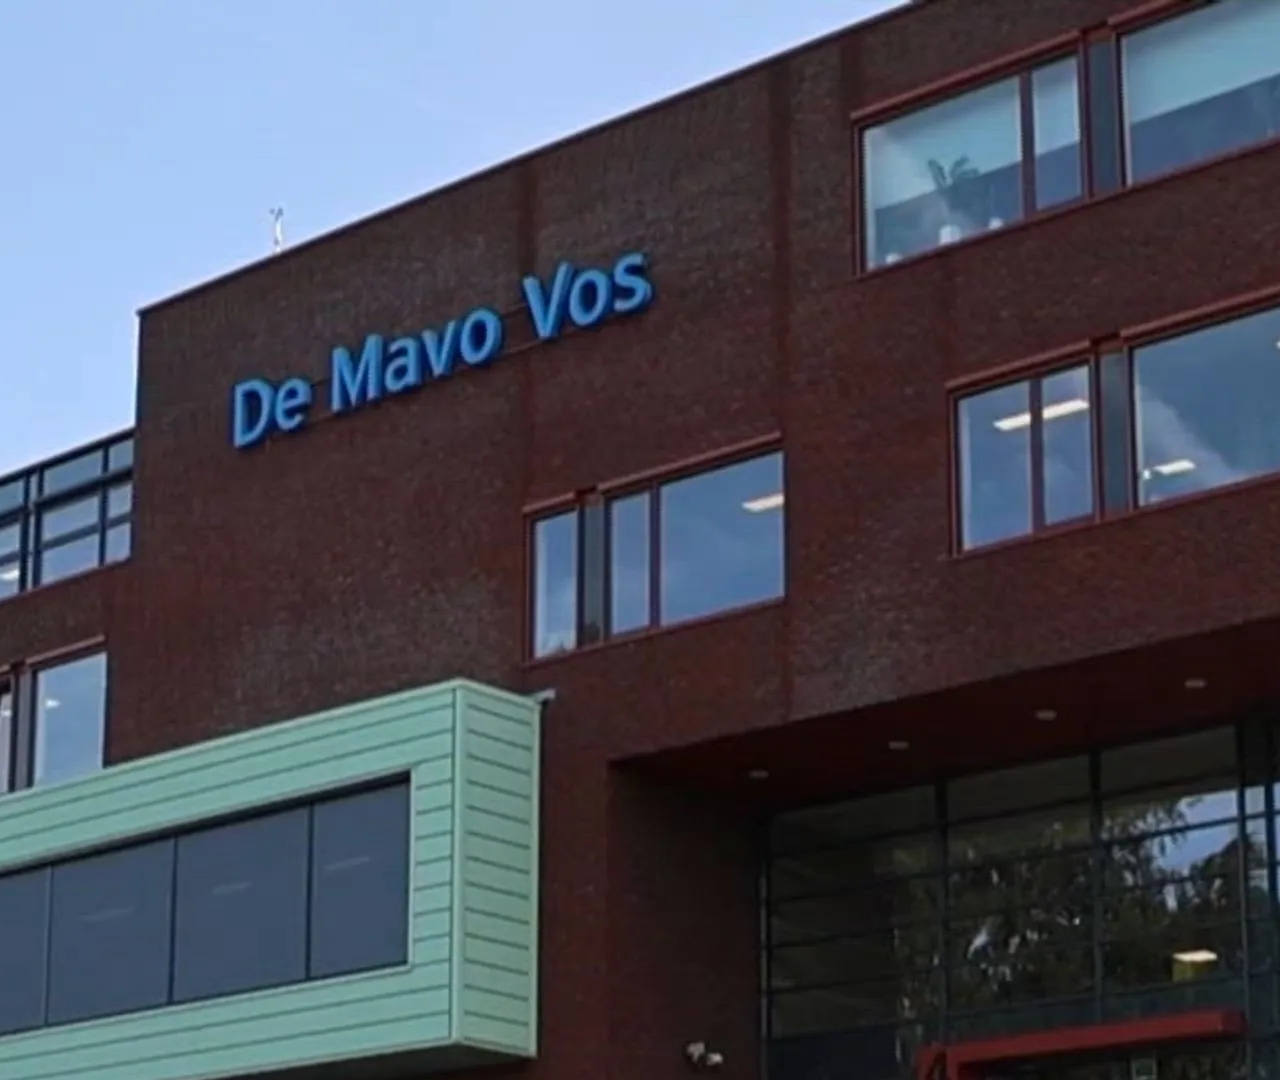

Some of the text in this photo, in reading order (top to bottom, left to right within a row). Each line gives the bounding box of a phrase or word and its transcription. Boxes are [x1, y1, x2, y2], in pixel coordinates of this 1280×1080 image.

[233, 251, 652, 448] De Mavo Vos
